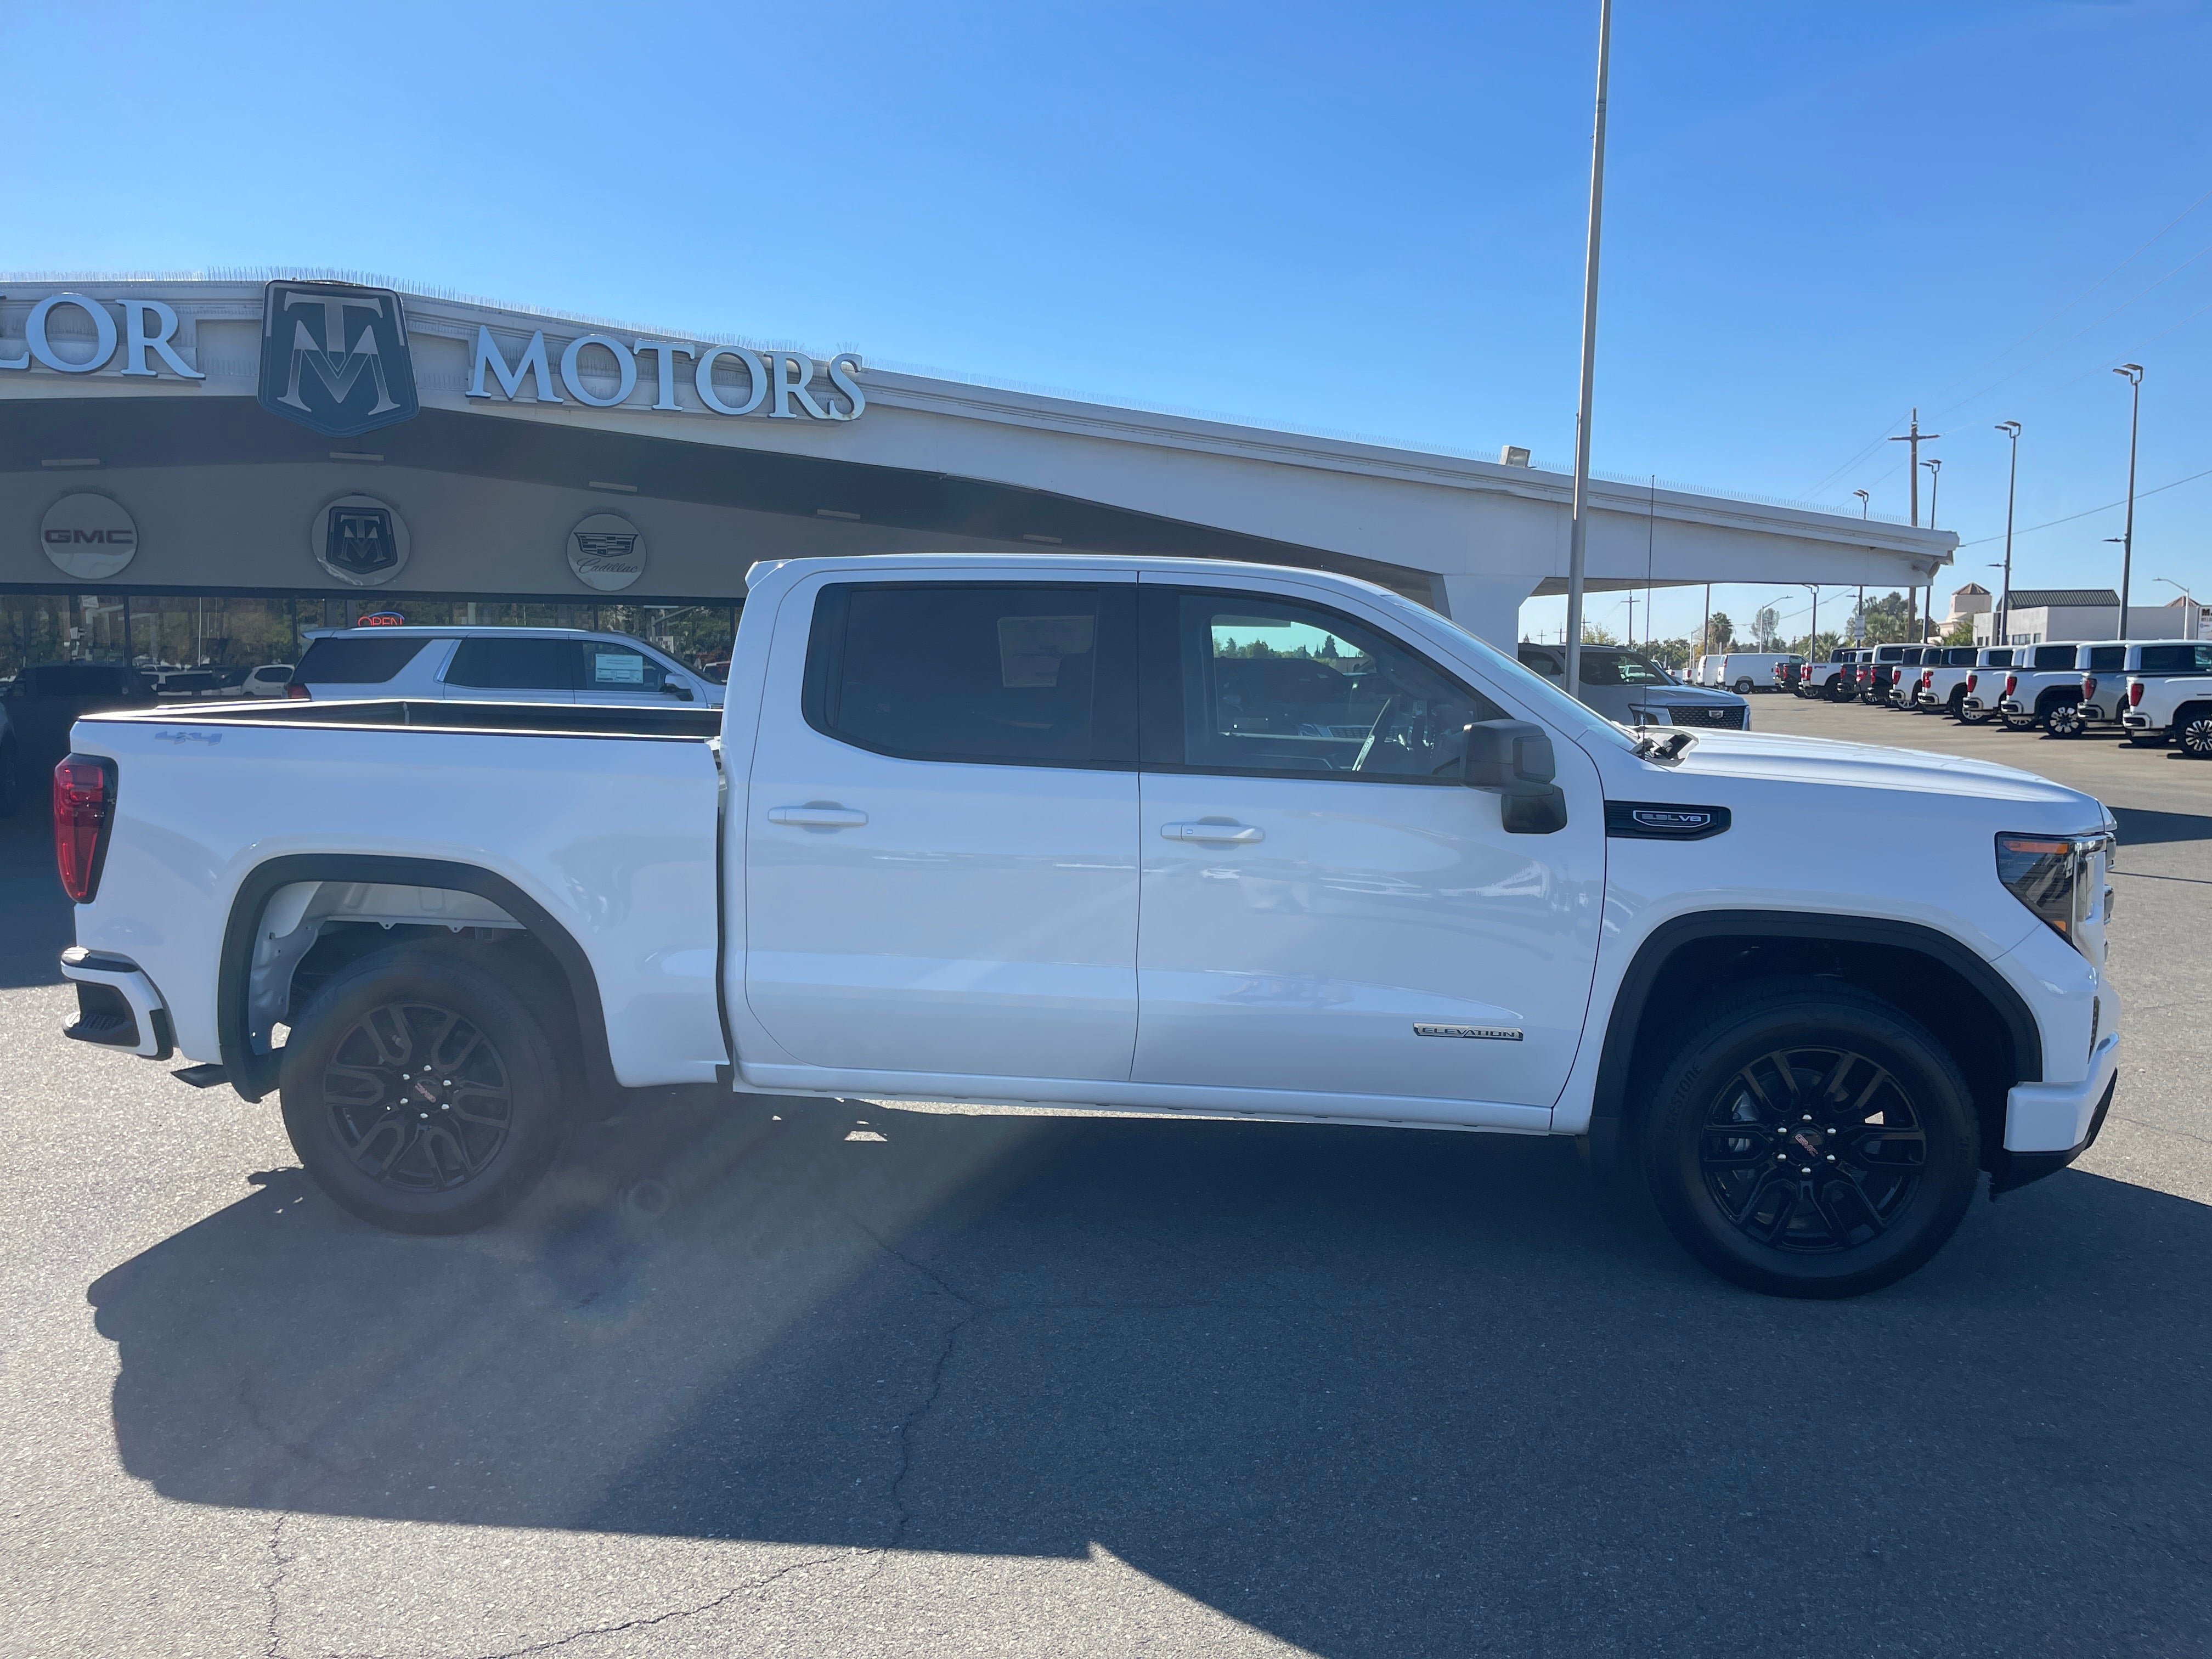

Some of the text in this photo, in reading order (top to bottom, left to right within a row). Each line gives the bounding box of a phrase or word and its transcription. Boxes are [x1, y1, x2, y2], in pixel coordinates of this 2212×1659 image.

[465, 325, 866, 421] MOTORS
[44, 529, 134, 544] GMC
[577, 558, 638, 573] Cadillac
[358, 616, 402, 627] OPEN
[1422, 1027, 1515, 1037] ELEVATION
[1795, 1133, 1819, 1157] GMC
